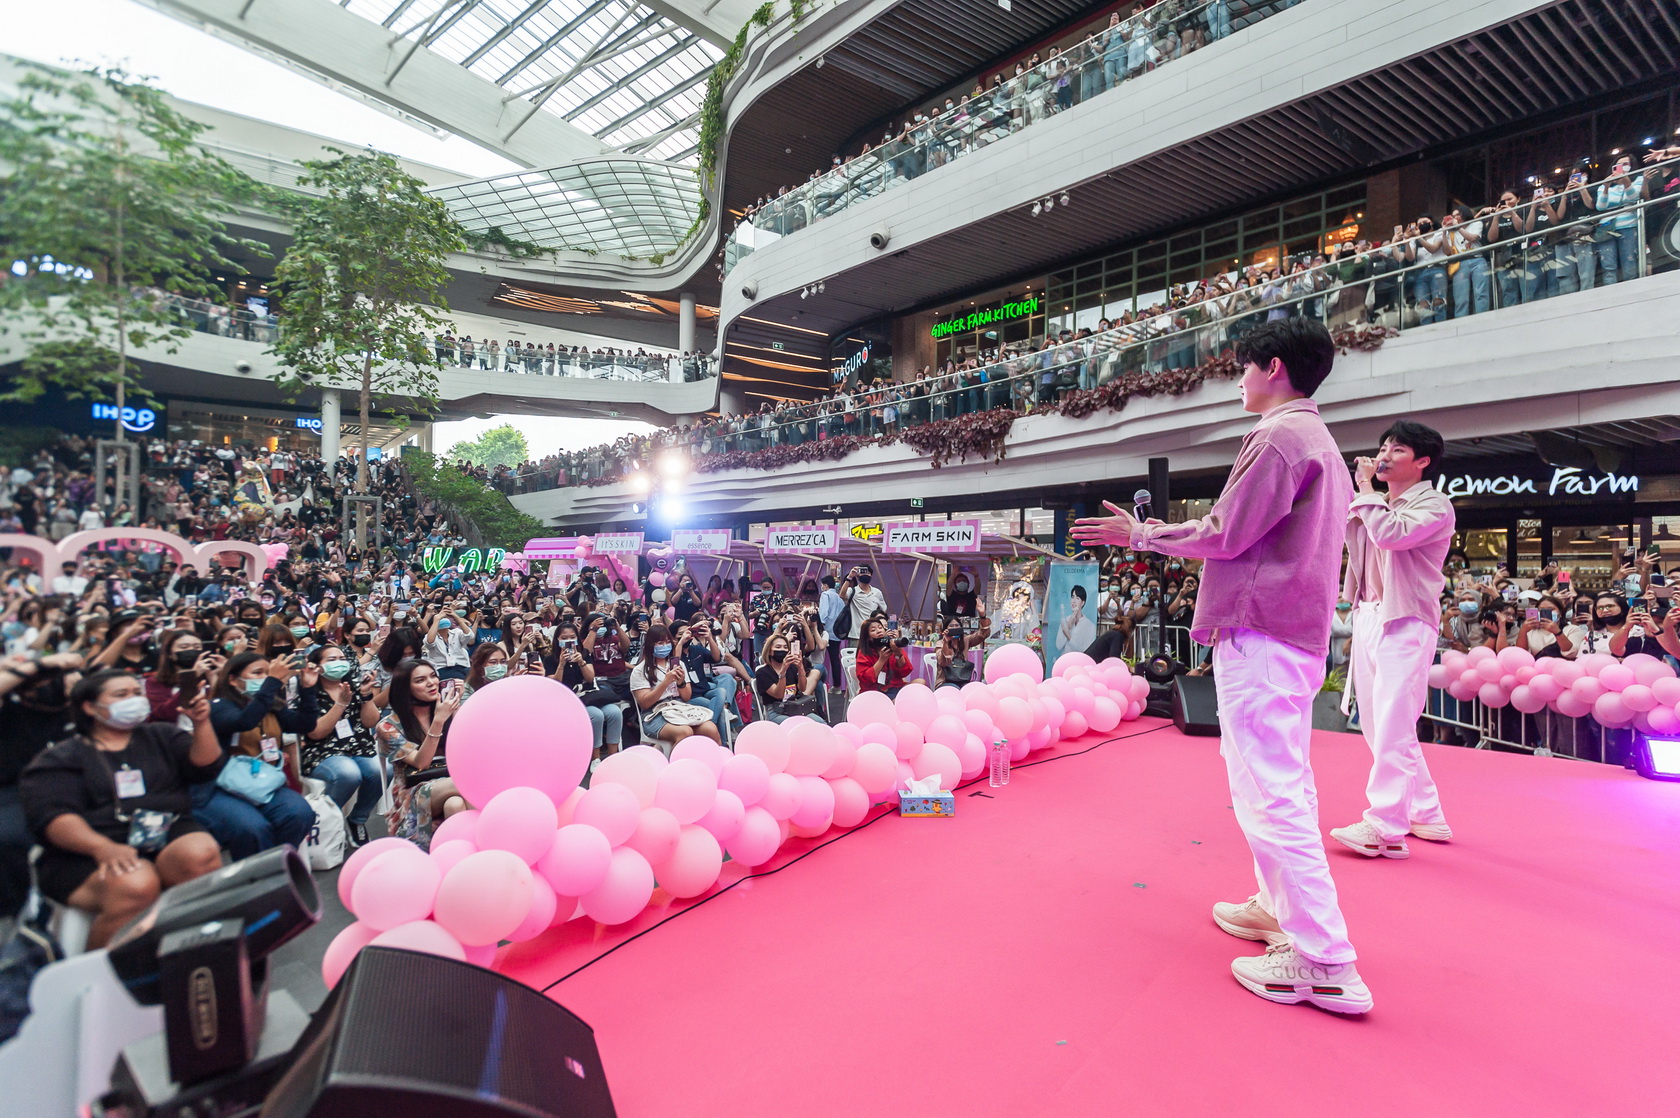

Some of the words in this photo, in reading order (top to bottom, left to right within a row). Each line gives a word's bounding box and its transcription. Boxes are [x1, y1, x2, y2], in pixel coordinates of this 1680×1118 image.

[930, 319, 967, 338] GINGER
[966, 311, 993, 330] FARM
[993, 297, 1039, 323] KITCHEN
[833, 346, 869, 384] MAGURO
[296, 417, 322, 429] IHO
[1436, 474, 1538, 499] Lemon
[1548, 467, 1639, 496] Farm
[614, 539, 635, 549] SKIN
[775, 532, 827, 546] MERREZ'CA
[891, 532, 931, 544] FARM
[936, 530, 972, 543] SKIN
[687, 541, 712, 550] essence
[1271, 965, 1331, 981] GUCCI
